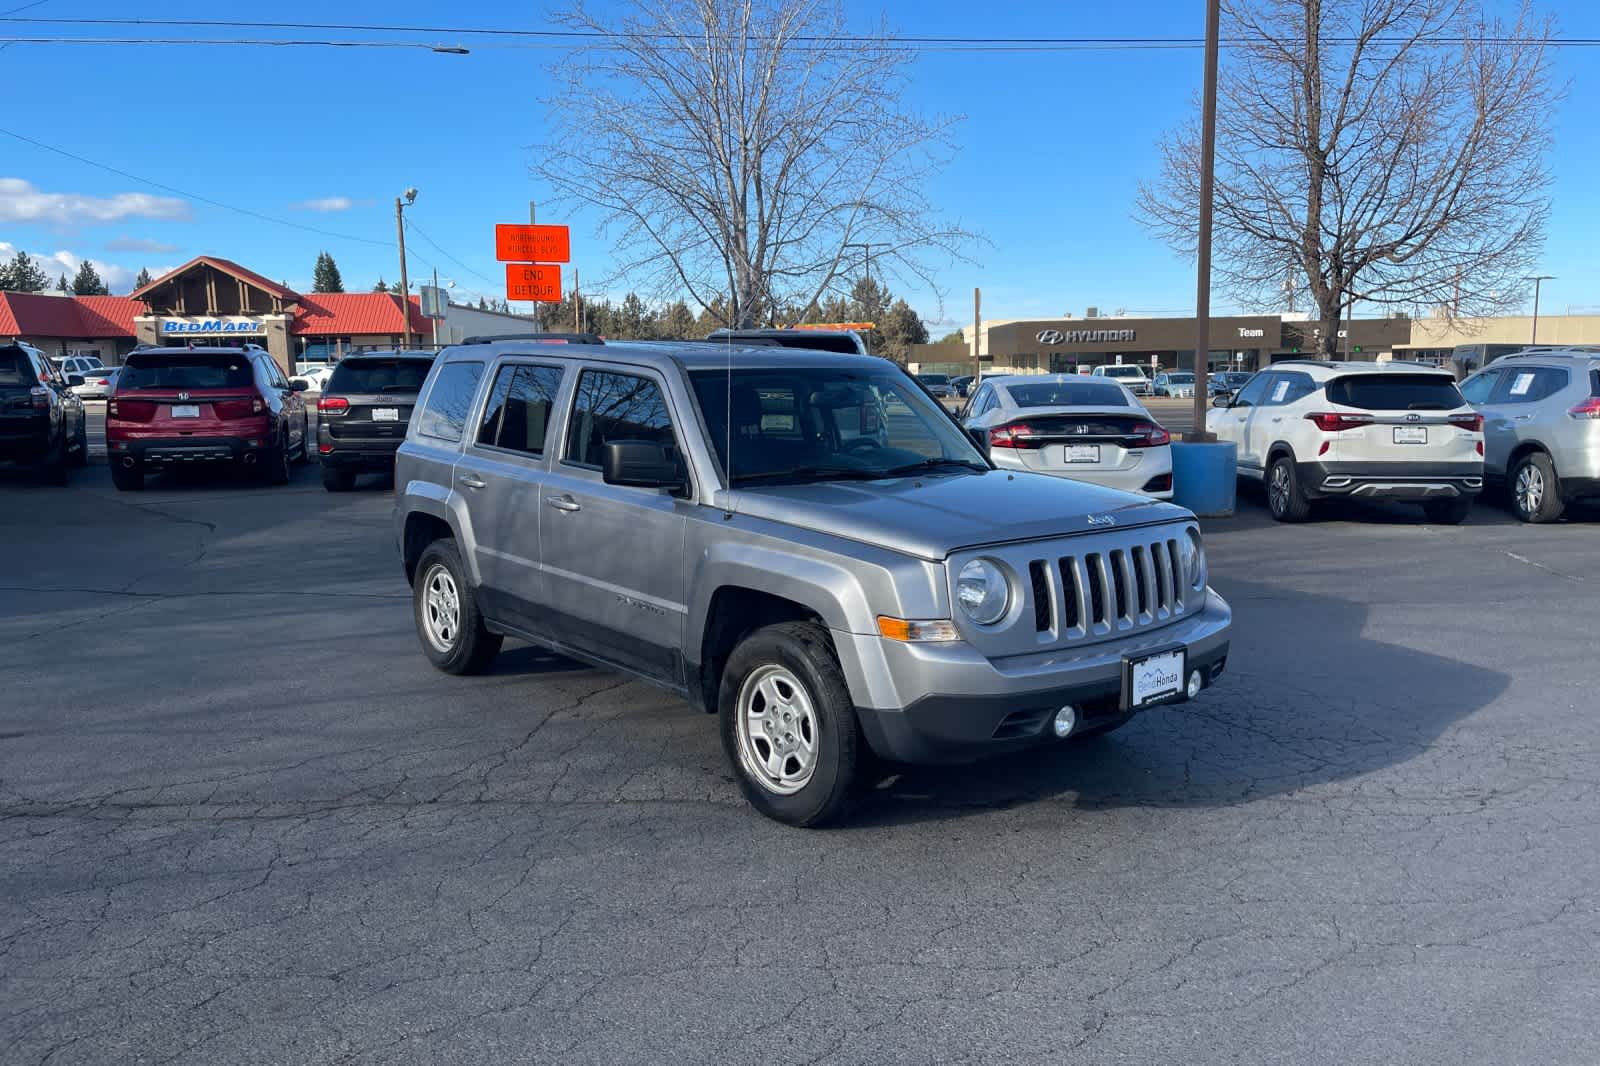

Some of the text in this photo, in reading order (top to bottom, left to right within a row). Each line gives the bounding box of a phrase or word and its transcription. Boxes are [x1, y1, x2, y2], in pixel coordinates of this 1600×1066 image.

[523, 269, 543, 281] END
[512, 285, 553, 296] DETOUR
[1066, 329, 1135, 342] HYUNDAI
[1238, 327, 1264, 338] Team
